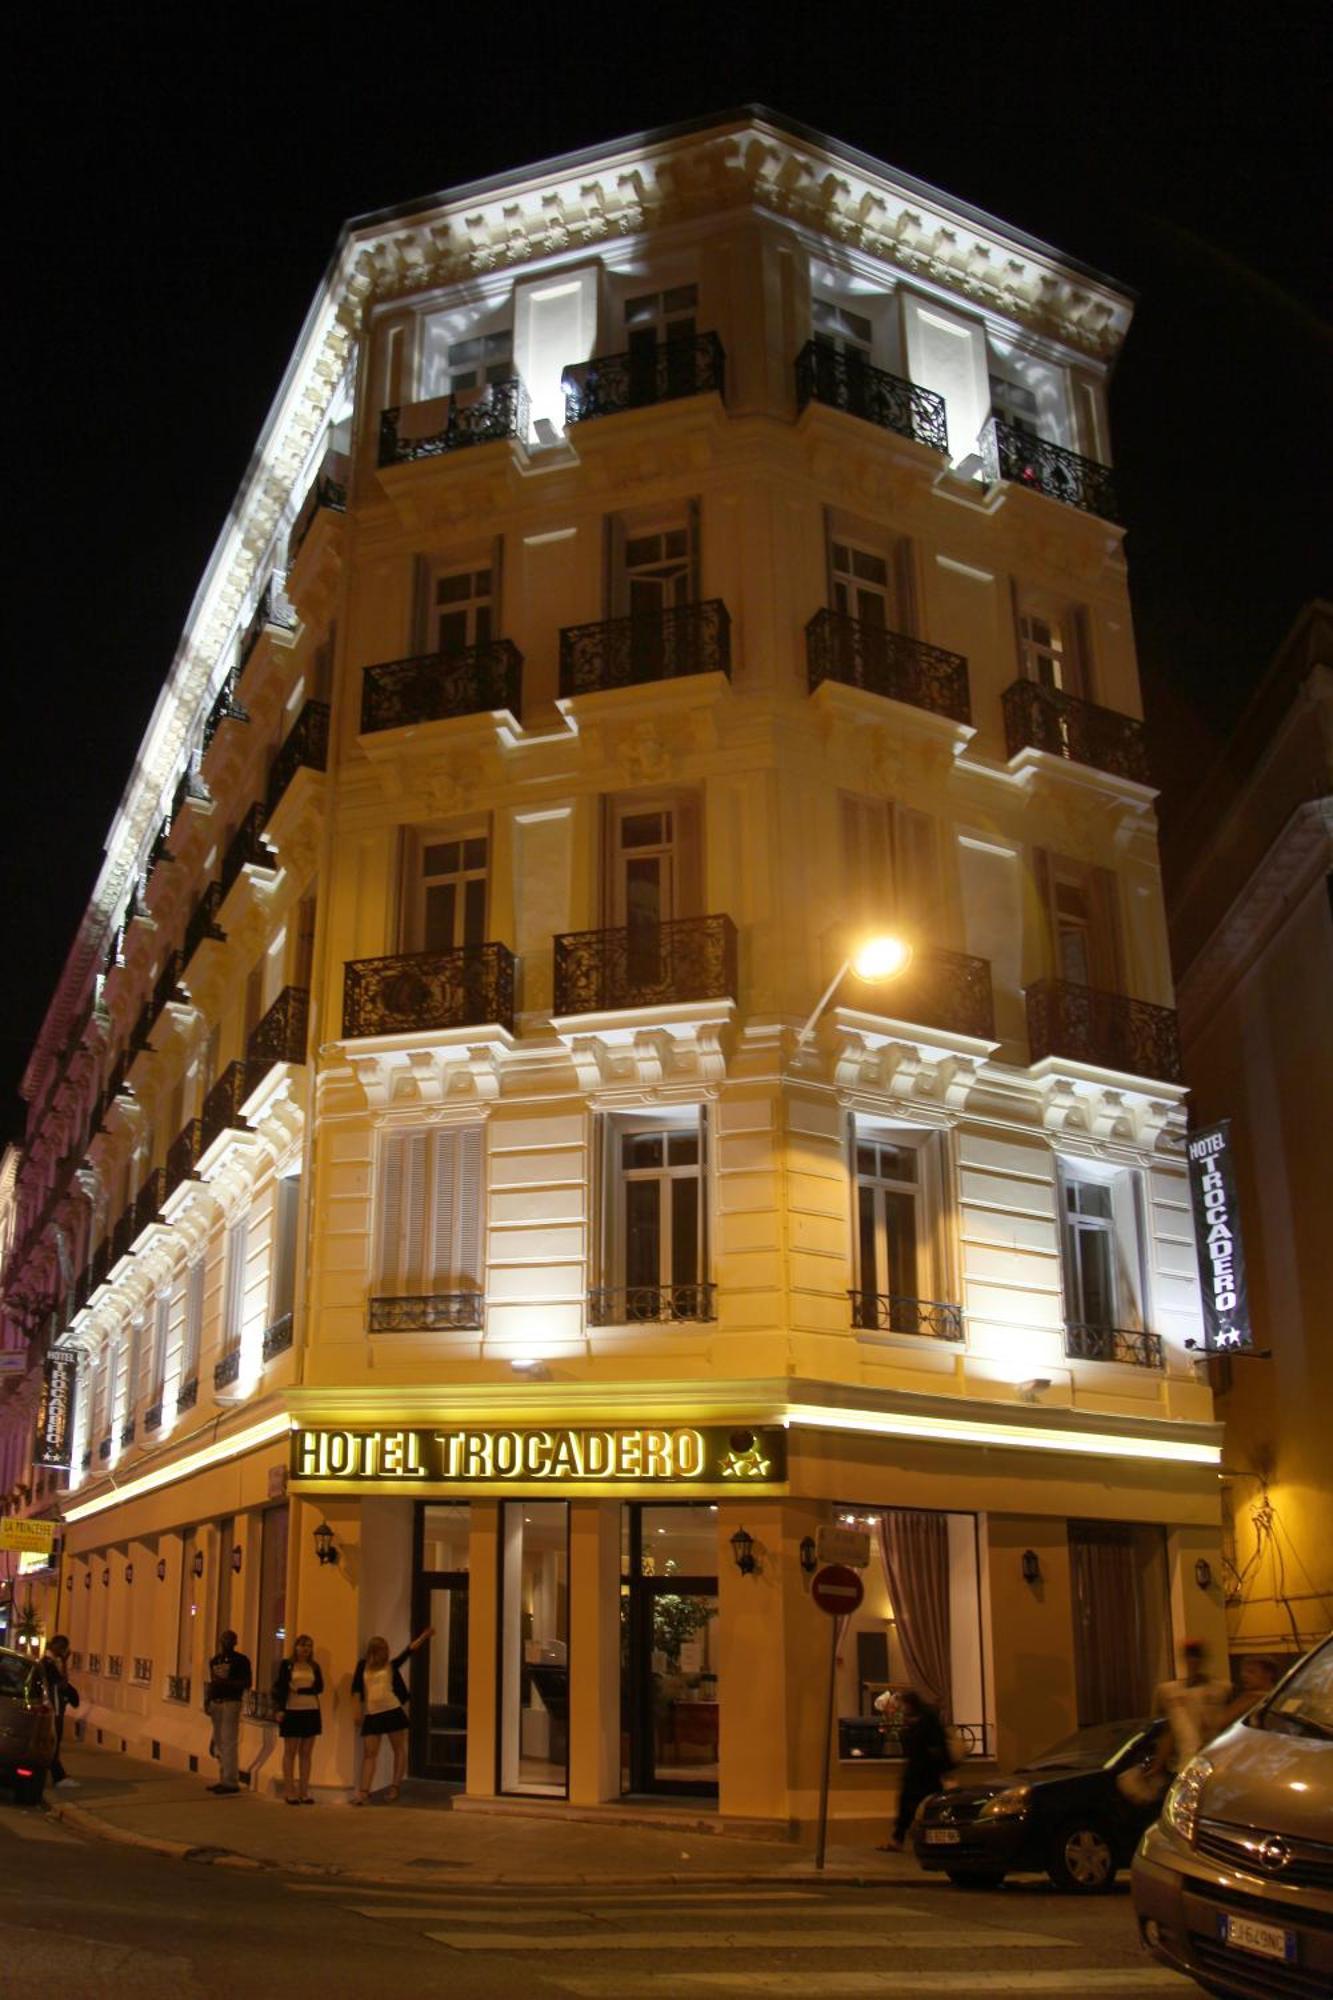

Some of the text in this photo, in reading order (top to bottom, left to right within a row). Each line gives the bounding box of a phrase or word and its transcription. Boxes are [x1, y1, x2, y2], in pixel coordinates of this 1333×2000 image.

[1189, 1132, 1226, 1161] HOTEL
[1200, 1153, 1237, 1312] TROCADERO
[47, 1350, 74, 1362] HOTEL
[46, 1361, 68, 1444] TROCADERO
[298, 1428, 705, 1477] HOTEL TROCADERO
